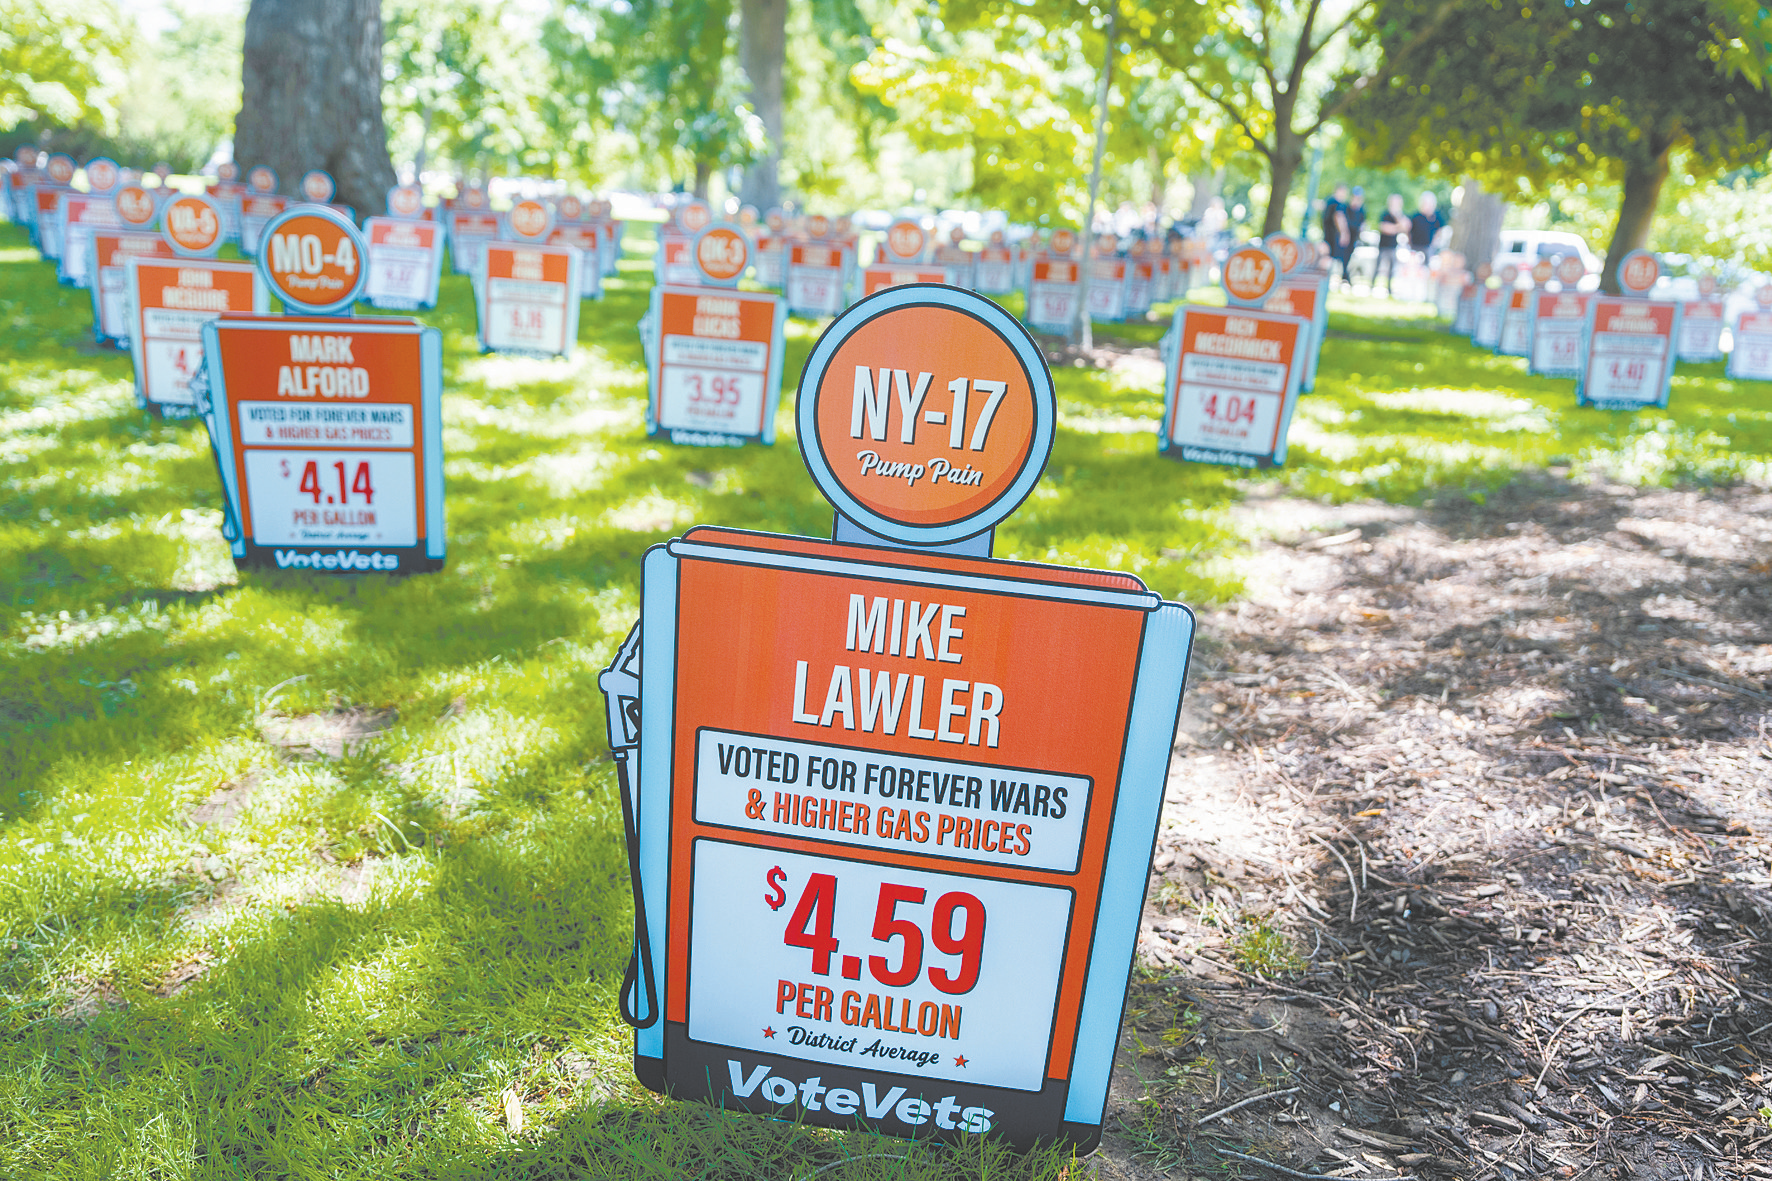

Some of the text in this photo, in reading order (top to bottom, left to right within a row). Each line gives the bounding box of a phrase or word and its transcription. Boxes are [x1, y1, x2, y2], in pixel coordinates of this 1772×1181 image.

[271, 233, 356, 275] MO-4
[1227, 255, 1273, 285] GA-7
[289, 335, 355, 363] MARK
[278, 366, 370, 398] ALFORD
[250, 407, 404, 423] VOTED FOR FOREVER WARS
[850, 365, 1008, 452] NY-17
[857, 450, 983, 487] Pump Pain
[294, 510, 376, 525] PER GALLON
[845, 592, 967, 664] MIKE
[792, 659, 1005, 748] LAWLER
[717, 743, 1069, 820] VOTED FOR FOREVER WARS
[744, 788, 1033, 857] & HIGHER GAS PRICES
[764, 865, 987, 996] $4.59
[776, 979, 963, 1040] PER GALLON
[787, 1025, 940, 1066] District Average
[727, 1059, 995, 1135] VoteVets
